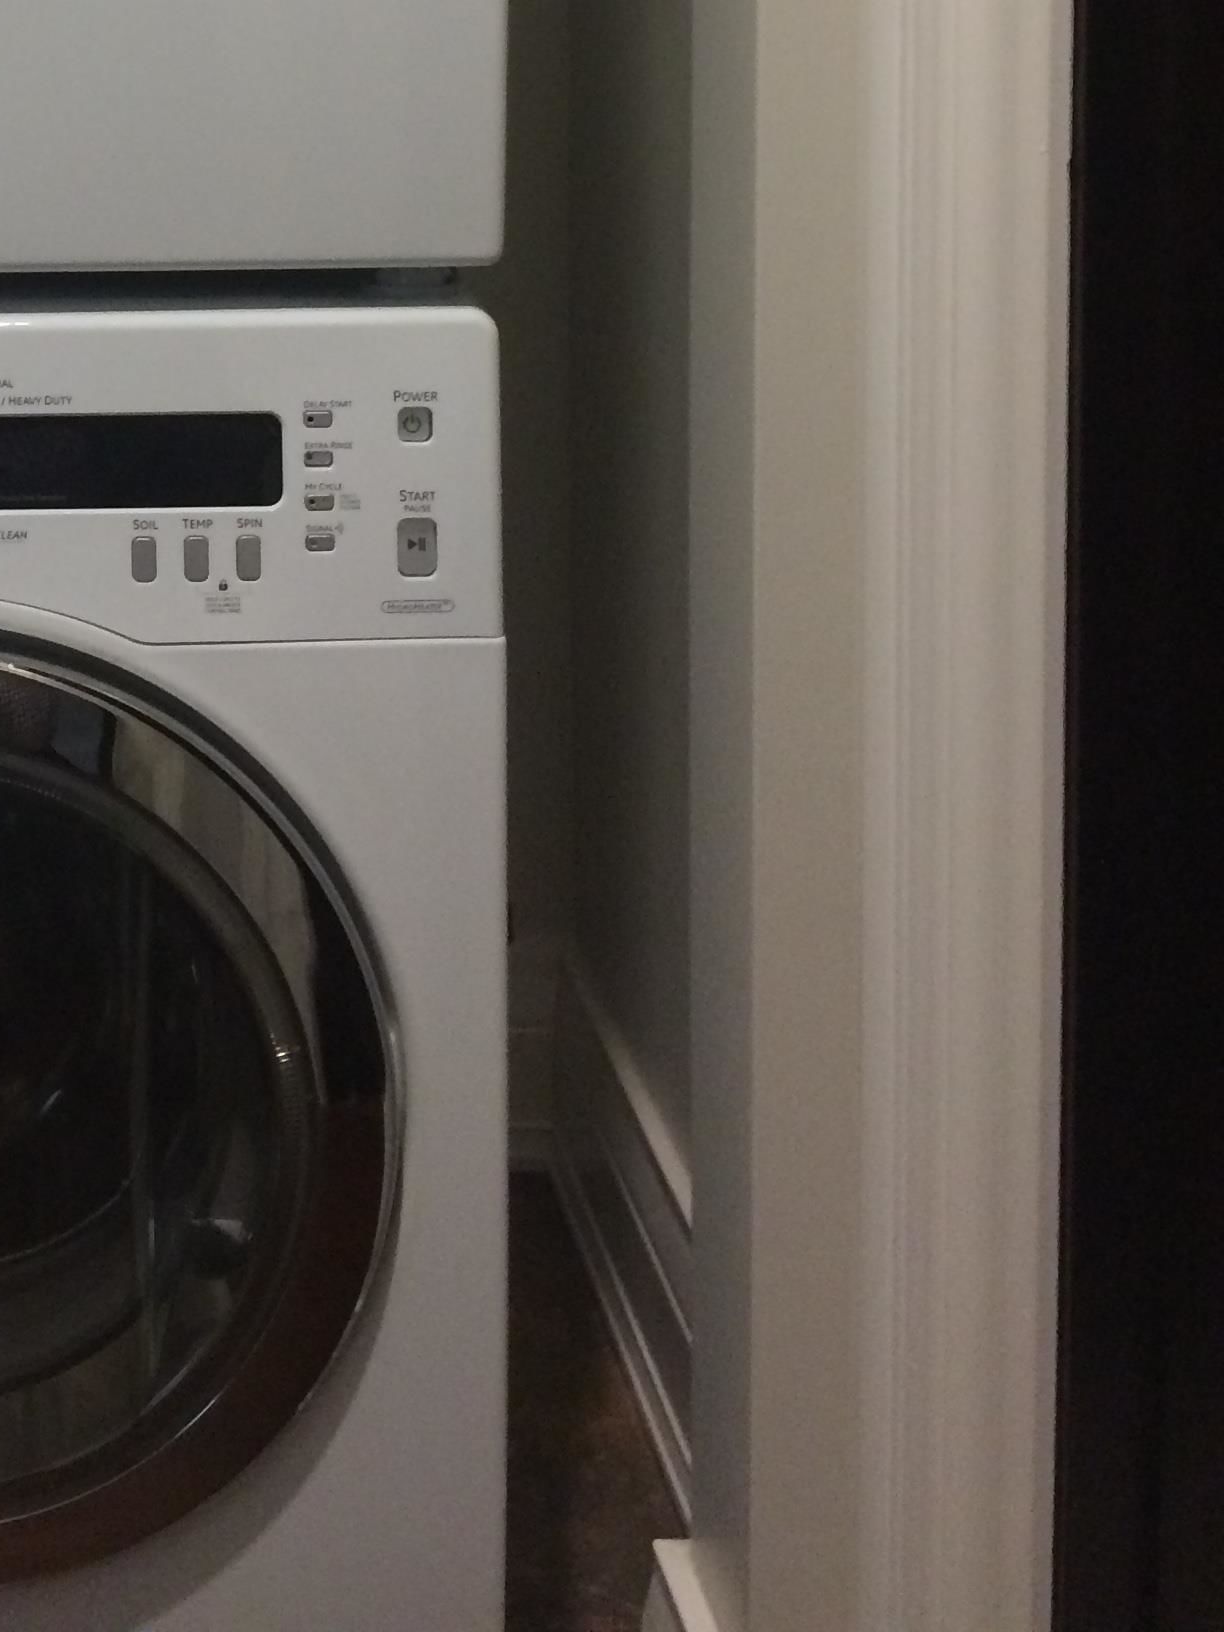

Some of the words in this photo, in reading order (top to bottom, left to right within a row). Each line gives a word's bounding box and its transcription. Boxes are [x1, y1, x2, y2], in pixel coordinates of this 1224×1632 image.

[9, 396, 41, 406] HEAVY
[44, 395, 73, 406] DUTY
[393, 389, 438, 402] POWER
[329, 399, 353, 408] START
[399, 489, 436, 502] START
[404, 504, 431, 513] PAUSE
[132, 519, 159, 530] SOIL
[181, 518, 214, 529] TEMP
[236, 517, 263, 529] SPIN
